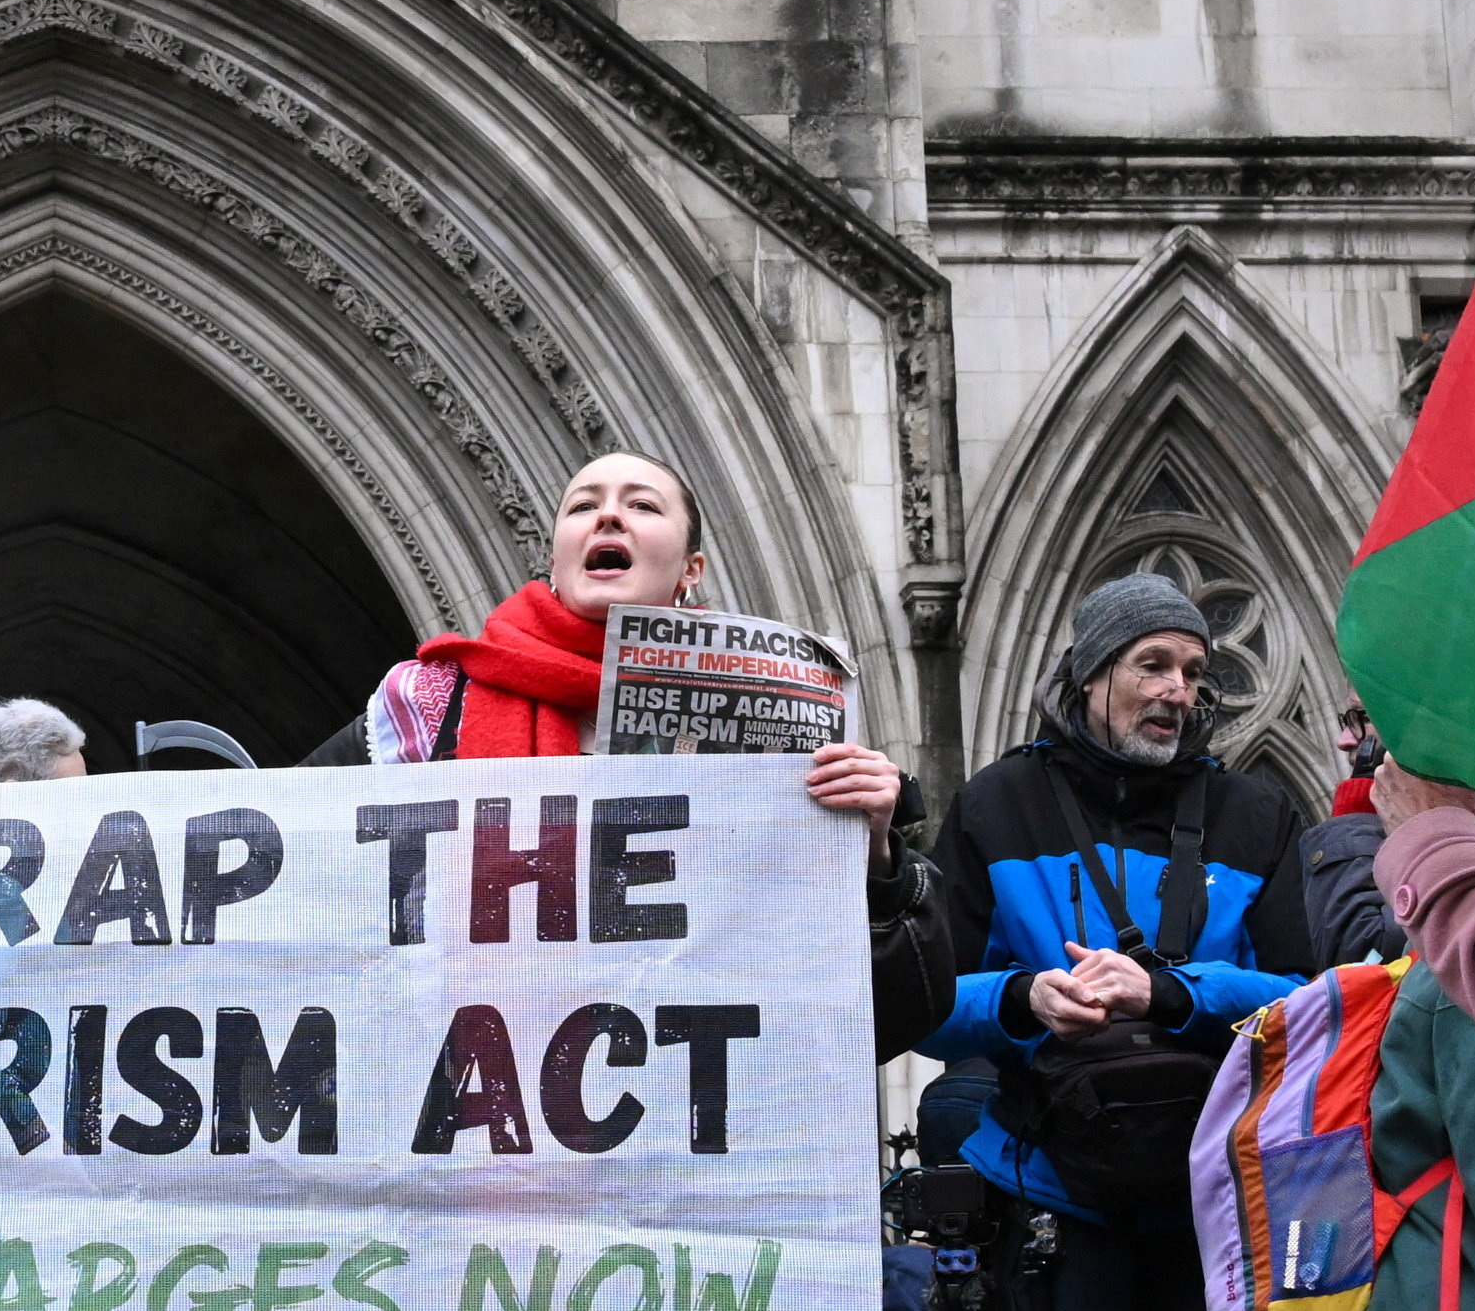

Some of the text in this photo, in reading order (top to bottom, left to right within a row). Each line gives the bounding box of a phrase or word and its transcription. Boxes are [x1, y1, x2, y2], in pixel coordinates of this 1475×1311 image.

[620, 614, 719, 649] FIGHT
[618, 645, 691, 670] FIGHT
[697, 652, 844, 692] IMPERIALISM!
[615, 708, 739, 744] RACISM
[618, 684, 681, 712] RISE
[690, 691, 730, 716] UP
[735, 695, 842, 730] AGAINST
[743, 732, 793, 749] SHOWS
[794, 736, 820, 751] THE
[744, 719, 832, 742] MINNEAPOLIS
[356, 795, 690, 946] THE
[411, 1003, 761, 1156] ACT
